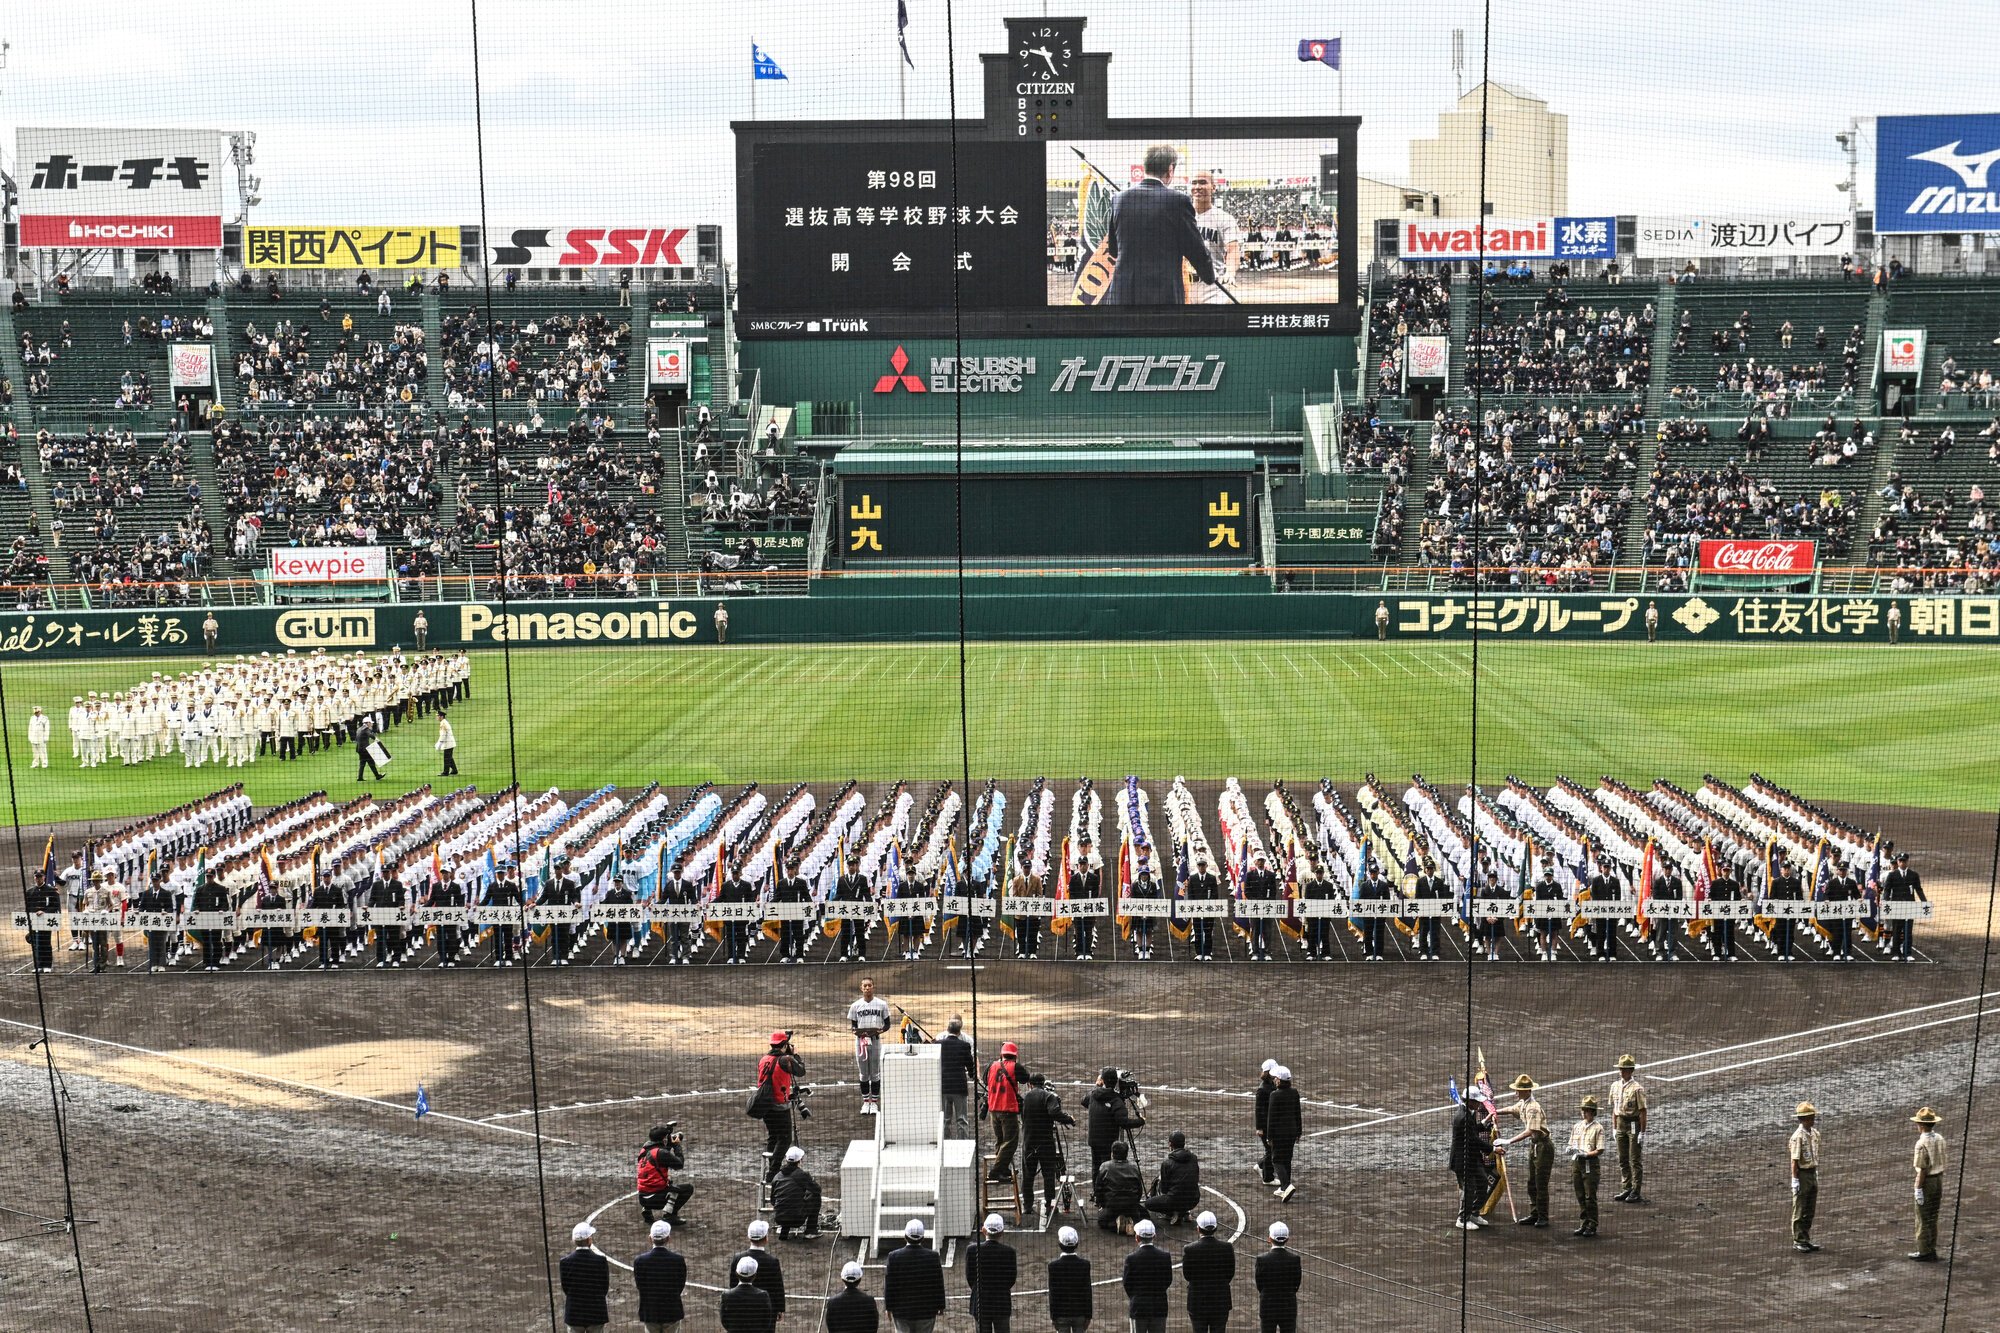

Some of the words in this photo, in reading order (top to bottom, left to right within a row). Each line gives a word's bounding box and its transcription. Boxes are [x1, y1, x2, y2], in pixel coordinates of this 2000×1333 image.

[1040, 28, 1051, 37] 12
[1019, 50, 1029, 59] 9
[1062, 49, 1071, 59] 3
[1041, 71, 1050, 80] 6
[1016, 83, 1075, 95] CITIZEN
[1018, 98, 1026, 109] B
[1018, 111, 1027, 123] S
[30, 155, 209, 189] ホーチキ
[867, 170, 936, 189] 第98回
[785, 205, 1019, 226] 選抜高等学校野球大会
[84, 225, 174, 238] HOCHIKI
[1407, 222, 1546, 253] Iwatani
[1561, 221, 1607, 244] 水素
[249, 230, 457, 265] 関西ペイント
[558, 229, 690, 265] SSK
[1561, 245, 1607, 256] エネルギー
[822, 318, 869, 332] Trunk
[1247, 314, 1330, 328] 三井住友銀行
[930, 357, 1036, 375] MITSUBISHI
[1050, 355, 1226, 392] オーロラビジョン
[930, 375, 1024, 393] ELECTRIC
[850, 494, 883, 551] 山九
[1208, 492, 1241, 548] 山九
[1283, 527, 1364, 540] 甲子園歴史館
[275, 551, 365, 580] kewpie
[1399, 597, 1639, 633] コナミグループ
[1729, 597, 1880, 635] 住友化学
[1909, 598, 2000, 636] 朝日
[460, 602, 697, 641] Panasonic
[45, 614, 188, 647] クオール薬局
[709, 907, 756, 918] 大垣日大
[767, 906, 813, 918] 三重
[827, 905, 876, 916] 日本文理
[887, 901, 935, 912] 帝京長岡
[946, 901, 994, 913] 近江
[1060, 901, 1106, 914] 大阪桐蔭
[1237, 904, 1287, 915] 智弁学園
[1297, 902, 1343, 915] 崇徳
[1352, 902, 1400, 914] 高川学園
[1407, 902, 1455, 914] 英明
[1648, 904, 1693, 916] 長崎日大
[1702, 904, 1749, 915] 長崎西
[1765, 903, 1813, 915] 熊本工
[1883, 905, 1931, 916] 帝京
[245, 913, 293, 923] 八戸学院光星
[302, 912, 348, 923] 花巻東
[361, 910, 407, 922] 東北
[419, 911, 465, 922] 佐野日大
[594, 907, 641, 919] 山梨学院
[652, 908, 699, 918] 中京大中京
[72, 916, 118, 927] 智弁和歌山
